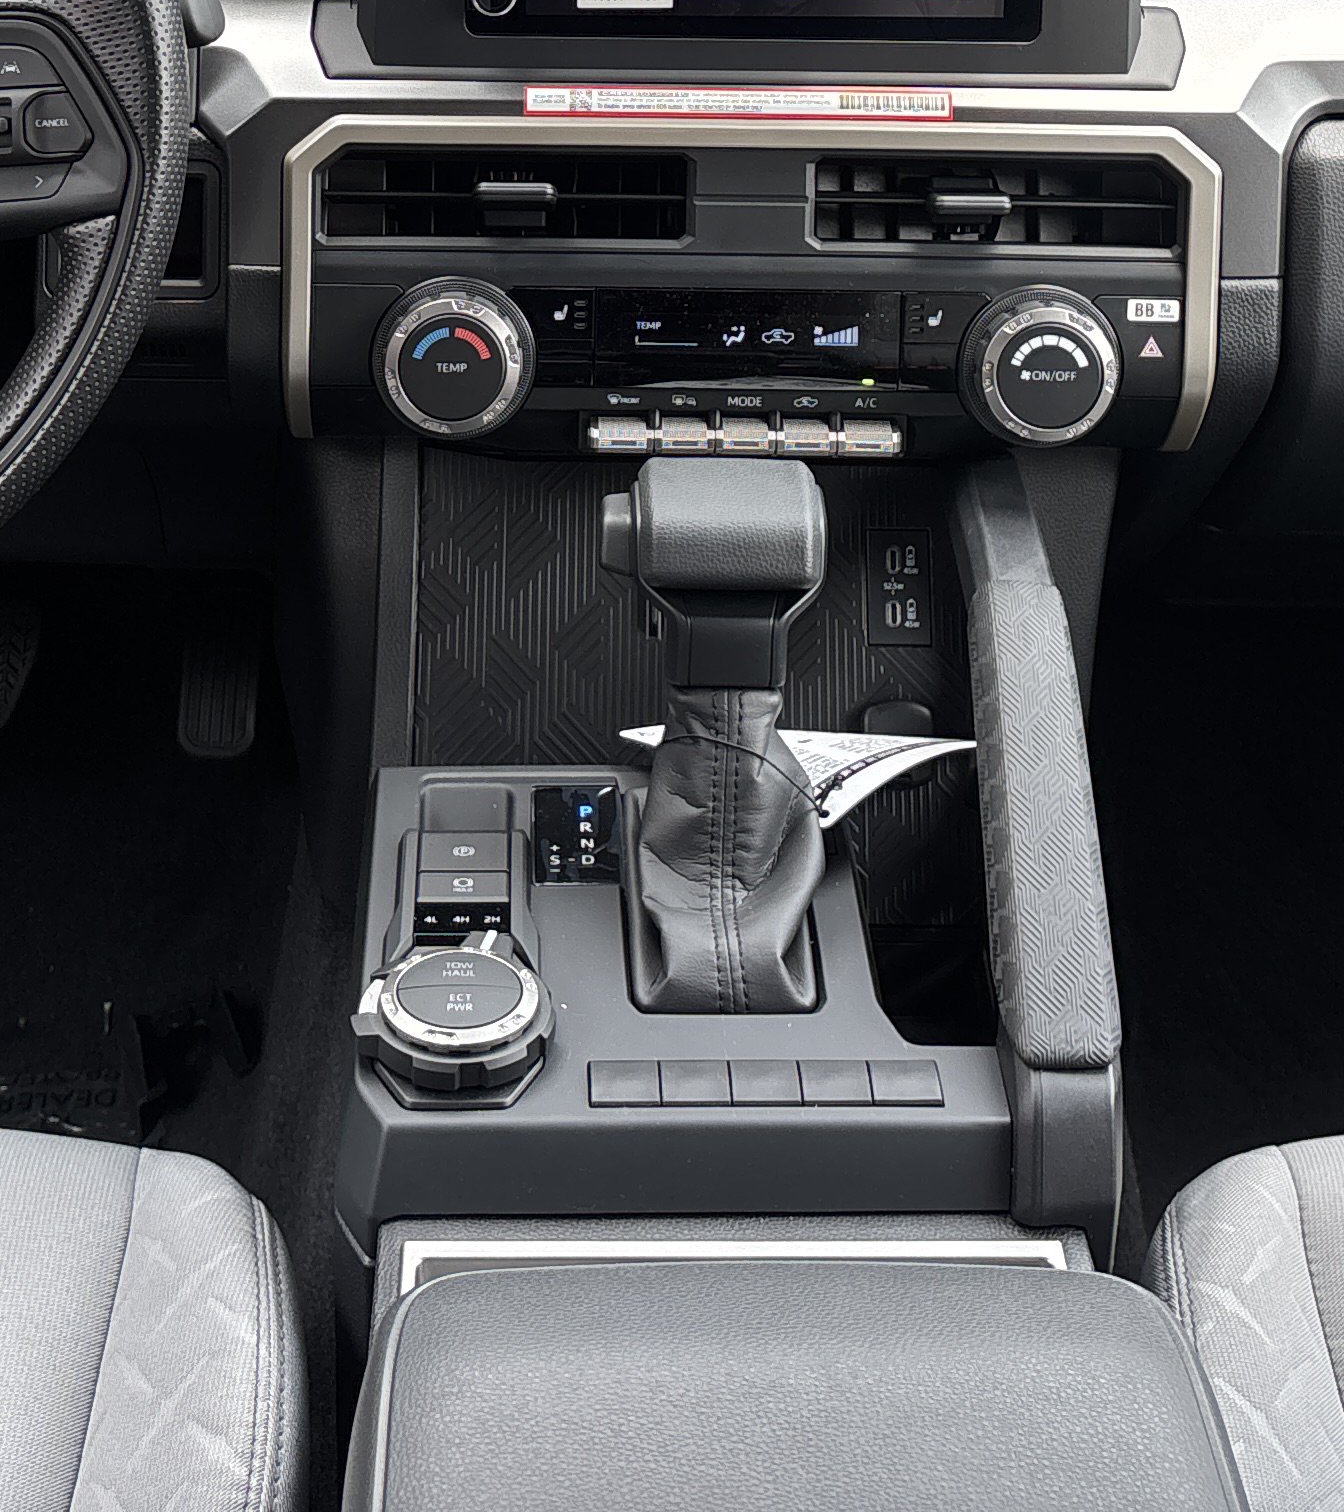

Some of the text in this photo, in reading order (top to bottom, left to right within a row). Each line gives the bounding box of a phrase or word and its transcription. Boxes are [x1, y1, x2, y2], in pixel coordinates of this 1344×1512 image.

[34, 118, 69, 128] CANCEL
[1134, 302, 1155, 318] BB
[636, 320, 662, 330] TEMP
[436, 362, 468, 373] TEMP
[1031, 370, 1077, 382] ON/OFF
[727, 395, 763, 408] MODE
[855, 396, 878, 409] A/C
[579, 805, 593, 818] P
[579, 821, 593, 833] R
[580, 838, 595, 849] N
[549, 854, 595, 866] S D
[424, 915, 501, 924] 4L 4H 2H
[445, 961, 474, 969] TOW
[442, 969, 476, 977] HAUL
[449, 993, 472, 1002] ECT
[446, 1002, 474, 1012] PWR
